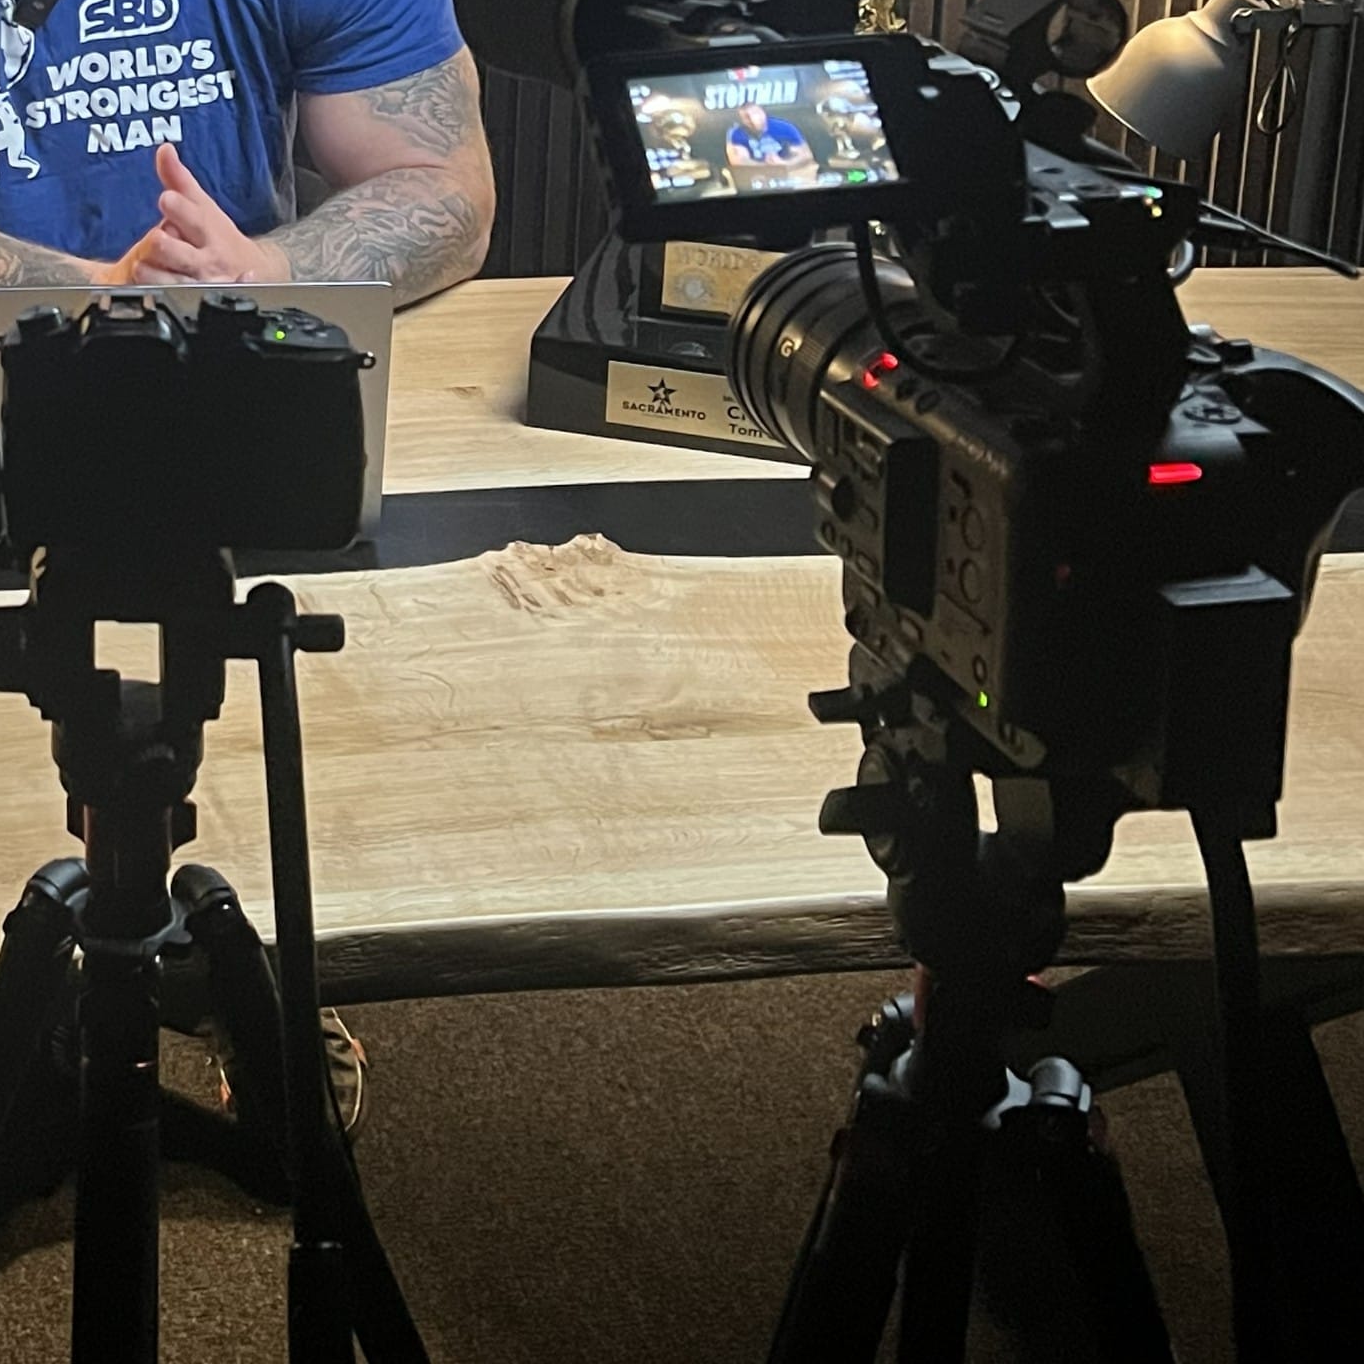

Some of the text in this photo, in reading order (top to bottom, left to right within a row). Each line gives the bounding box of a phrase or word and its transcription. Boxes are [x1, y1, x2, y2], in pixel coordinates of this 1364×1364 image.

[46, 39, 215, 91] WORLD'S
[25, 70, 236, 129] STRONGEST
[87, 115, 183, 153] MAN
[622, 400, 707, 421] SACRAMENTO
